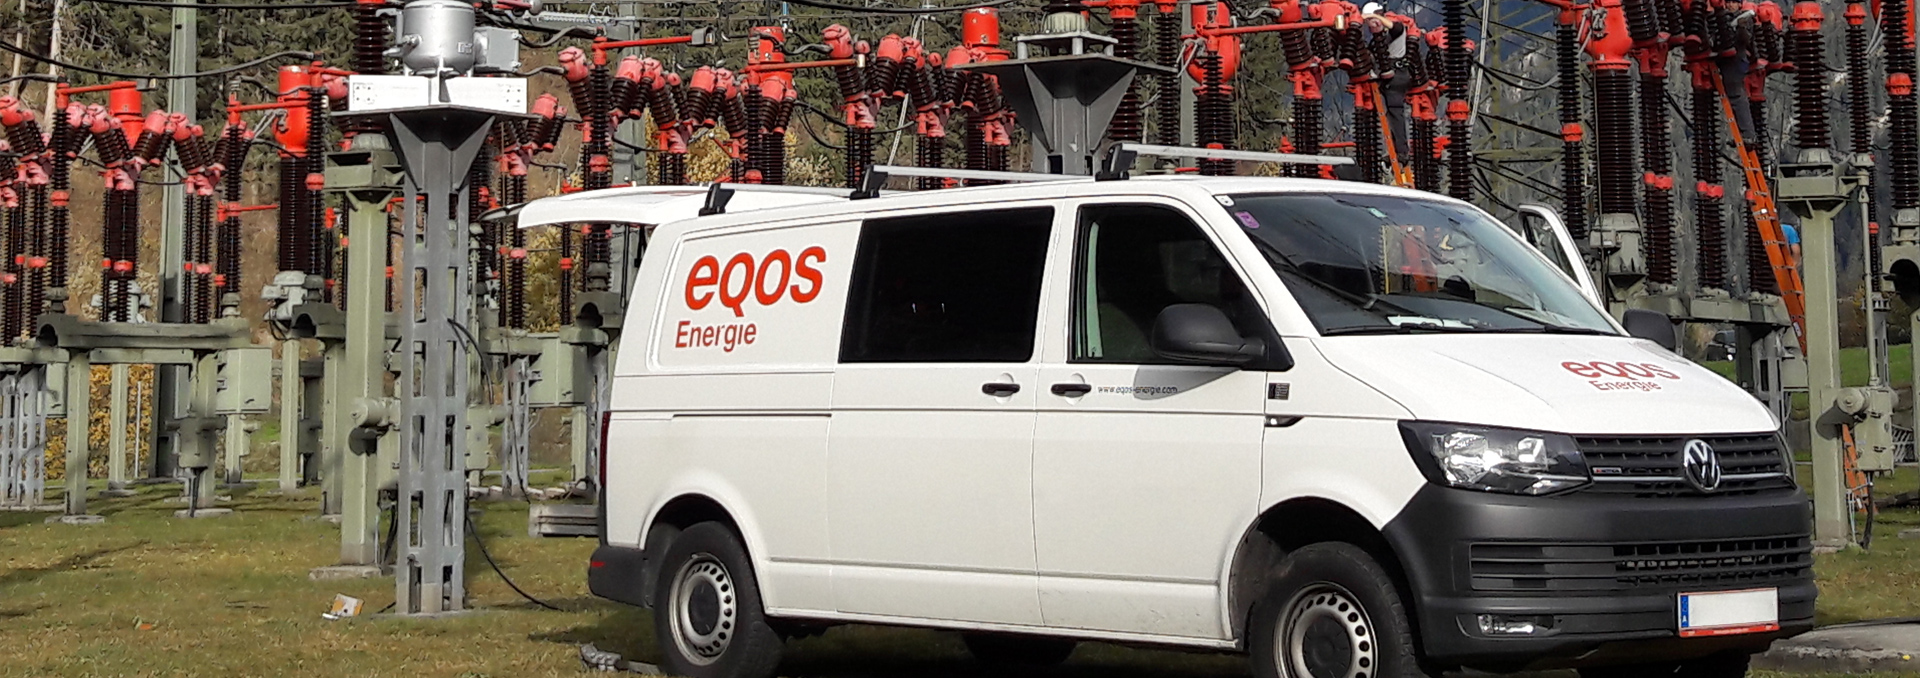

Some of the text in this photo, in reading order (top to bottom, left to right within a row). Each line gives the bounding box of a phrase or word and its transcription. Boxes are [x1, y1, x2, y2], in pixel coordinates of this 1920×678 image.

[685, 246, 826, 317] eqos
[676, 321, 757, 352] Energie
[1561, 361, 1680, 380] eqos
[1097, 386, 1178, 395] www.eqos-energie.com
[1589, 381, 1662, 392] Energie
